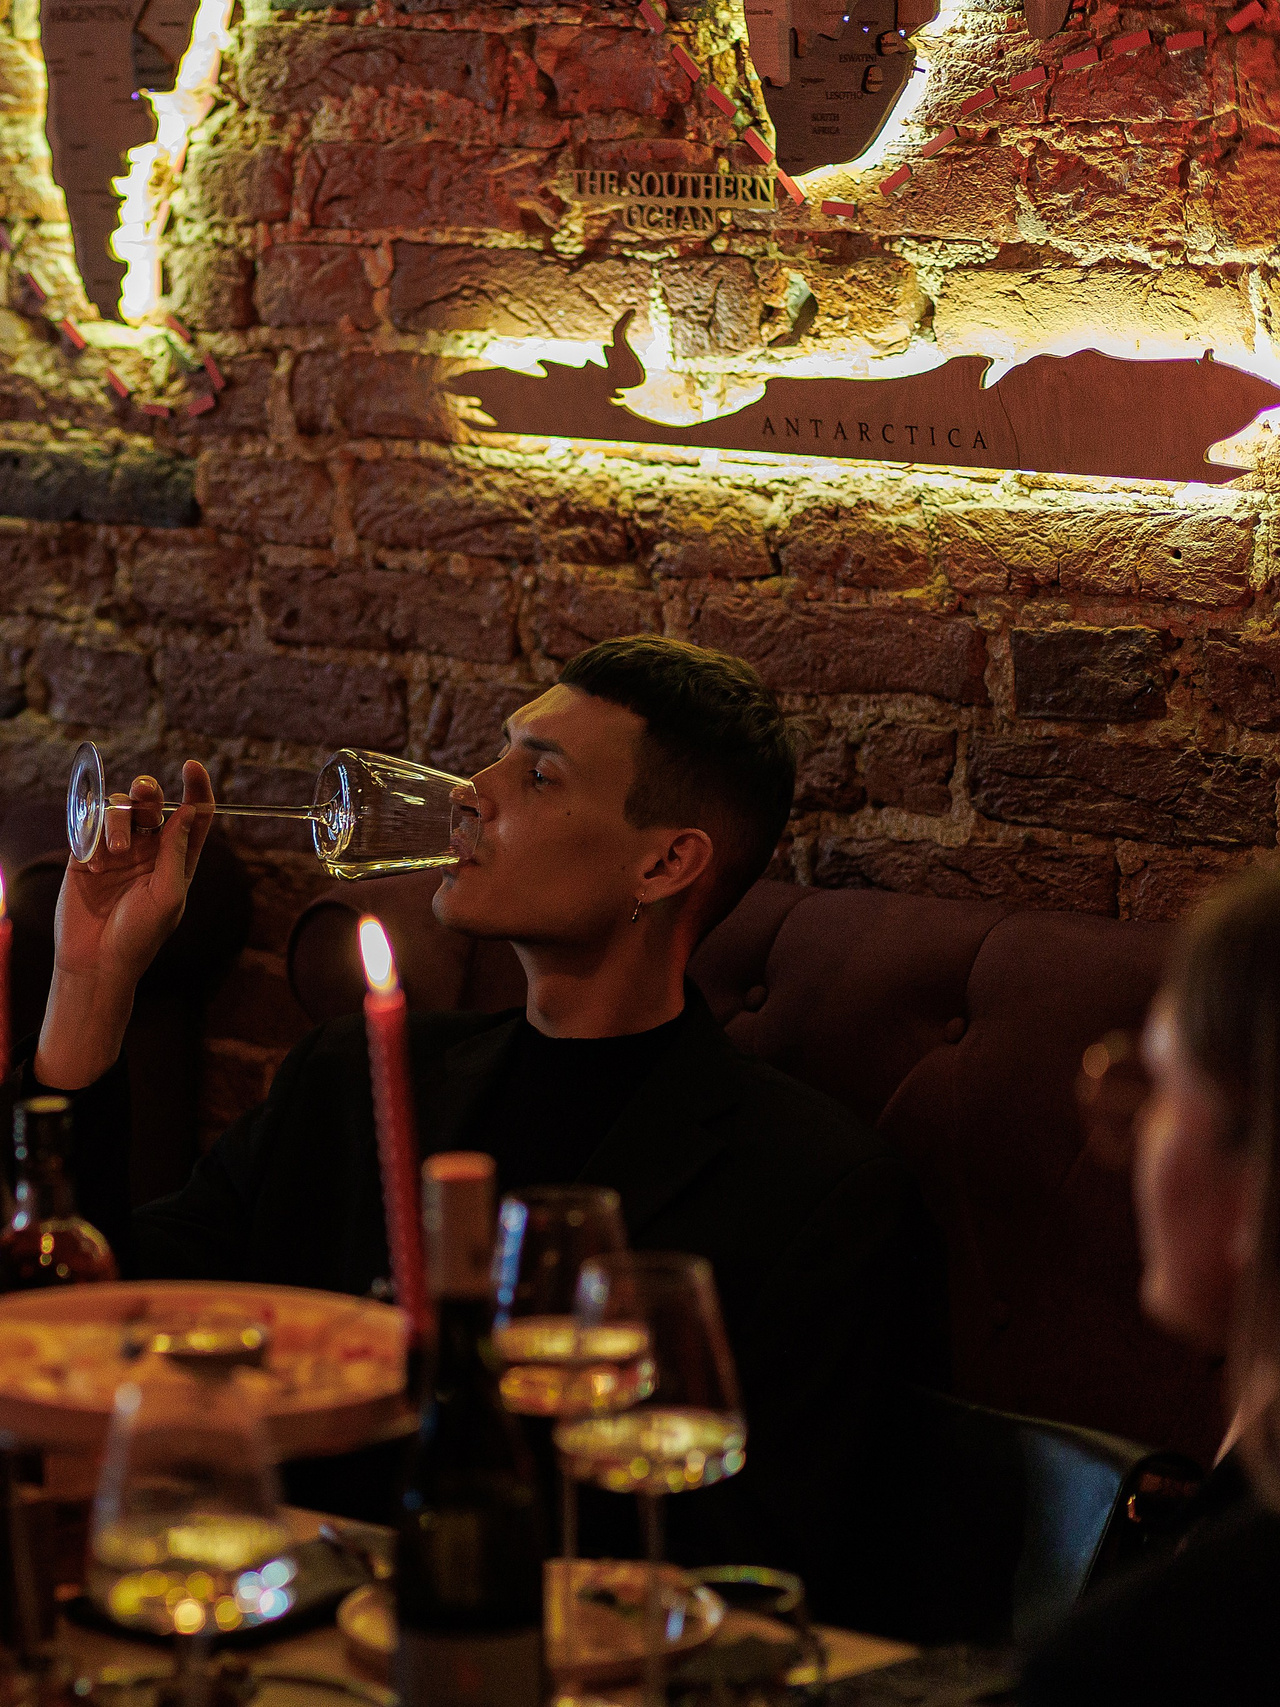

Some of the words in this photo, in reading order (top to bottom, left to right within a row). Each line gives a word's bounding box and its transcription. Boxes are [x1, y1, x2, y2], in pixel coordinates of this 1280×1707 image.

[825, 91, 864, 100] LESOTHO
[811, 113, 840, 122] SOUTH
[812, 126, 840, 135] AFRICA
[572, 169, 619, 197] THE
[626, 171, 775, 203] SOUTHERN
[623, 203, 718, 232] OCEAN
[761, 416, 988, 450] ANTARCTICA
